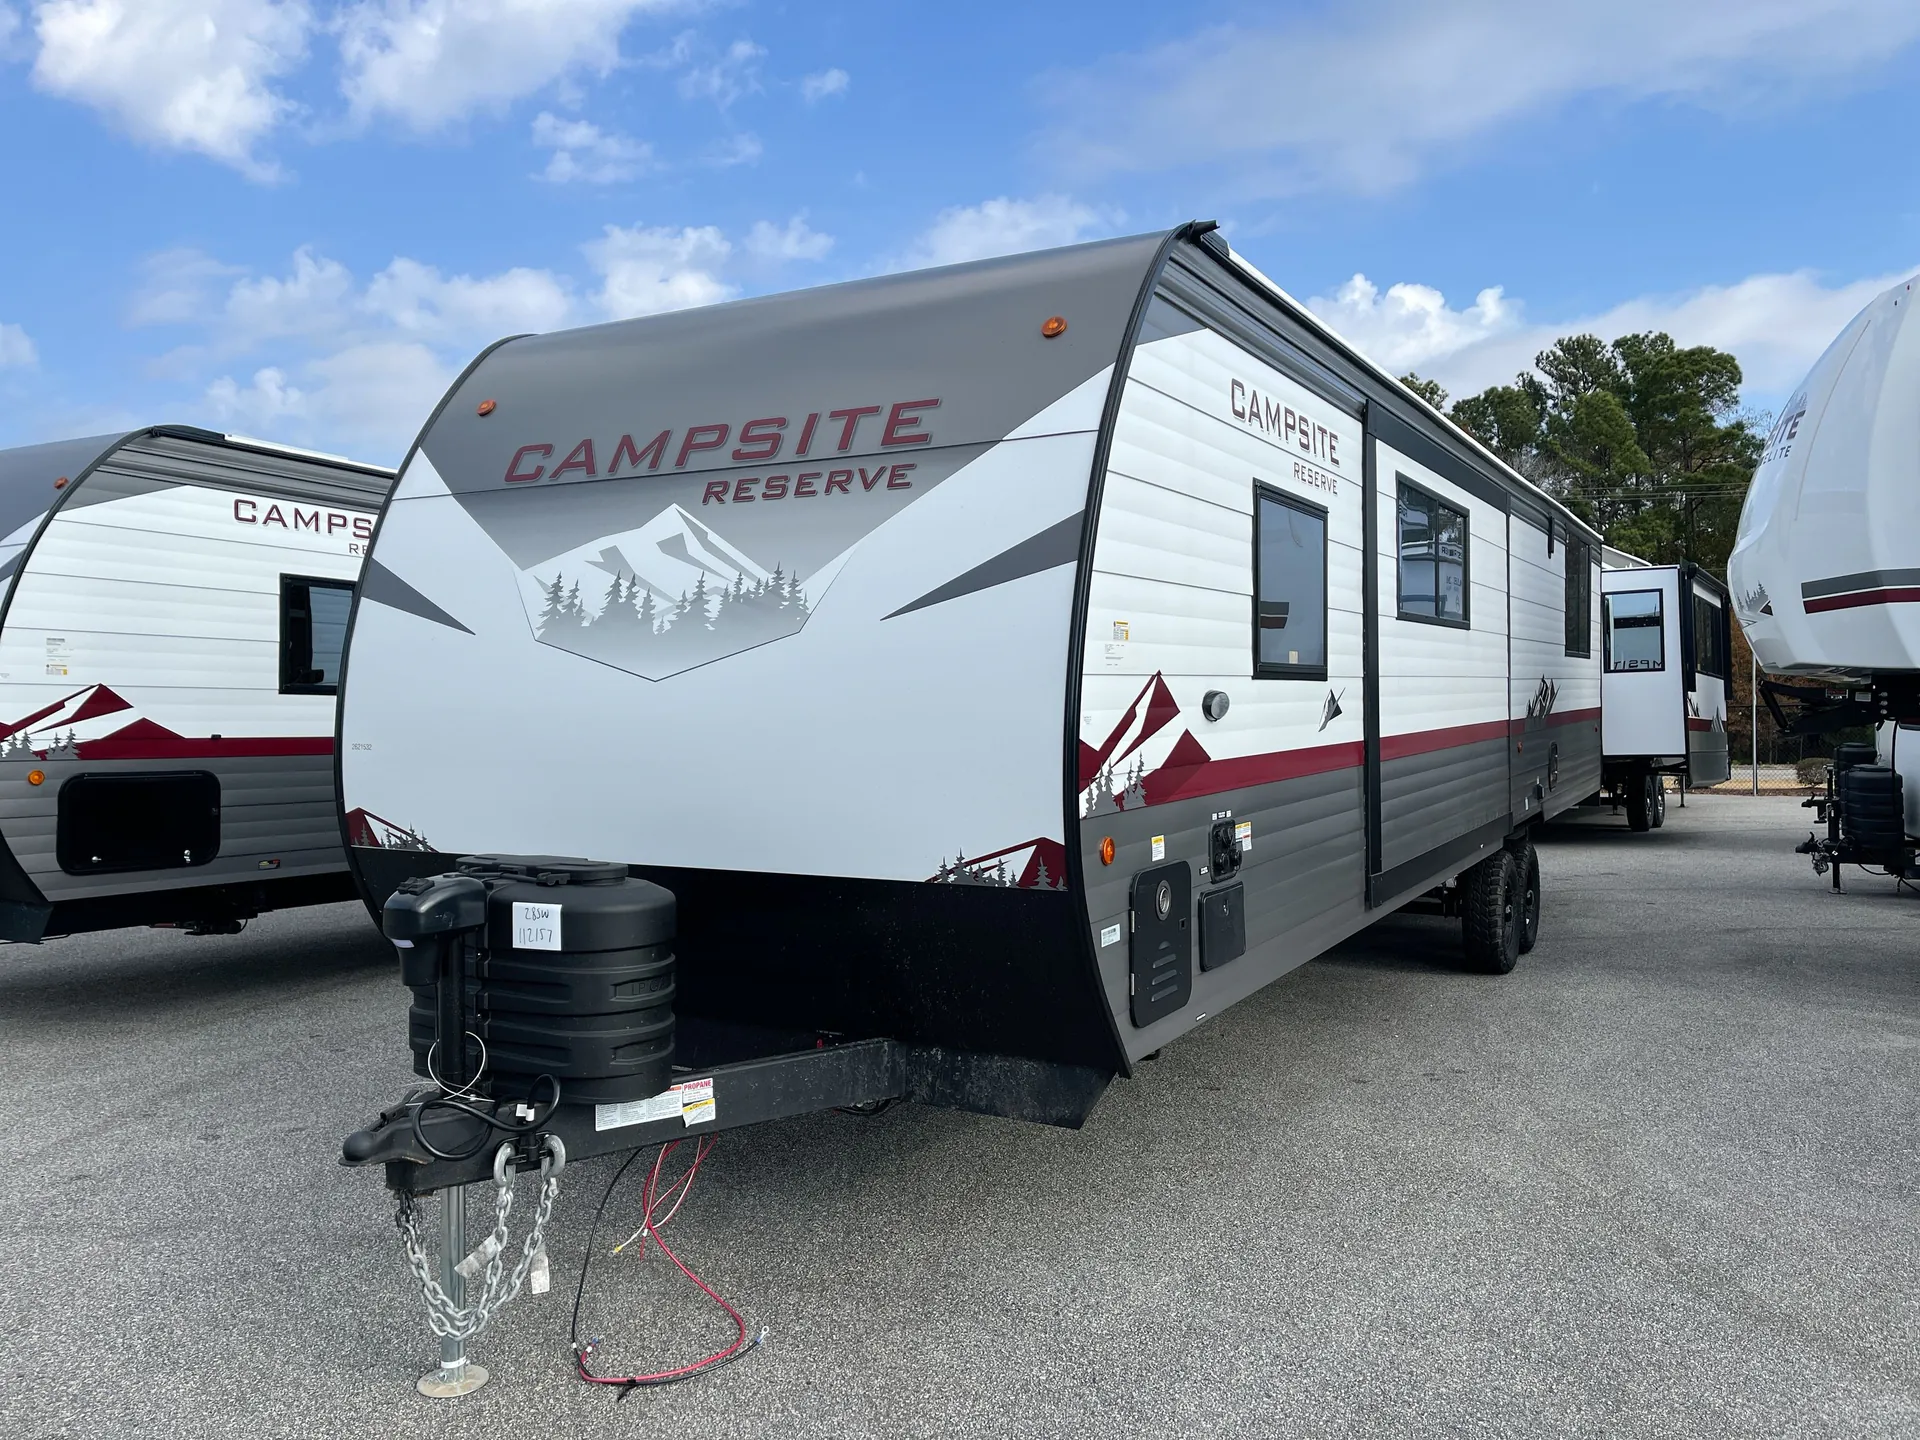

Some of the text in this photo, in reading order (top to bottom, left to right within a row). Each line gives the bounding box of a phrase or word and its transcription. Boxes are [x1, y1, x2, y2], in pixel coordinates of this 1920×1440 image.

[504, 398, 942, 484] CAMPSITE
[1231, 378, 1340, 467] CAMPSITE
[702, 463, 917, 506] RESERVE
[1293, 461, 1338, 495] RESERVE
[518, 928, 553, 944] 112157
[683, 1079, 712, 1091] PROPANE
